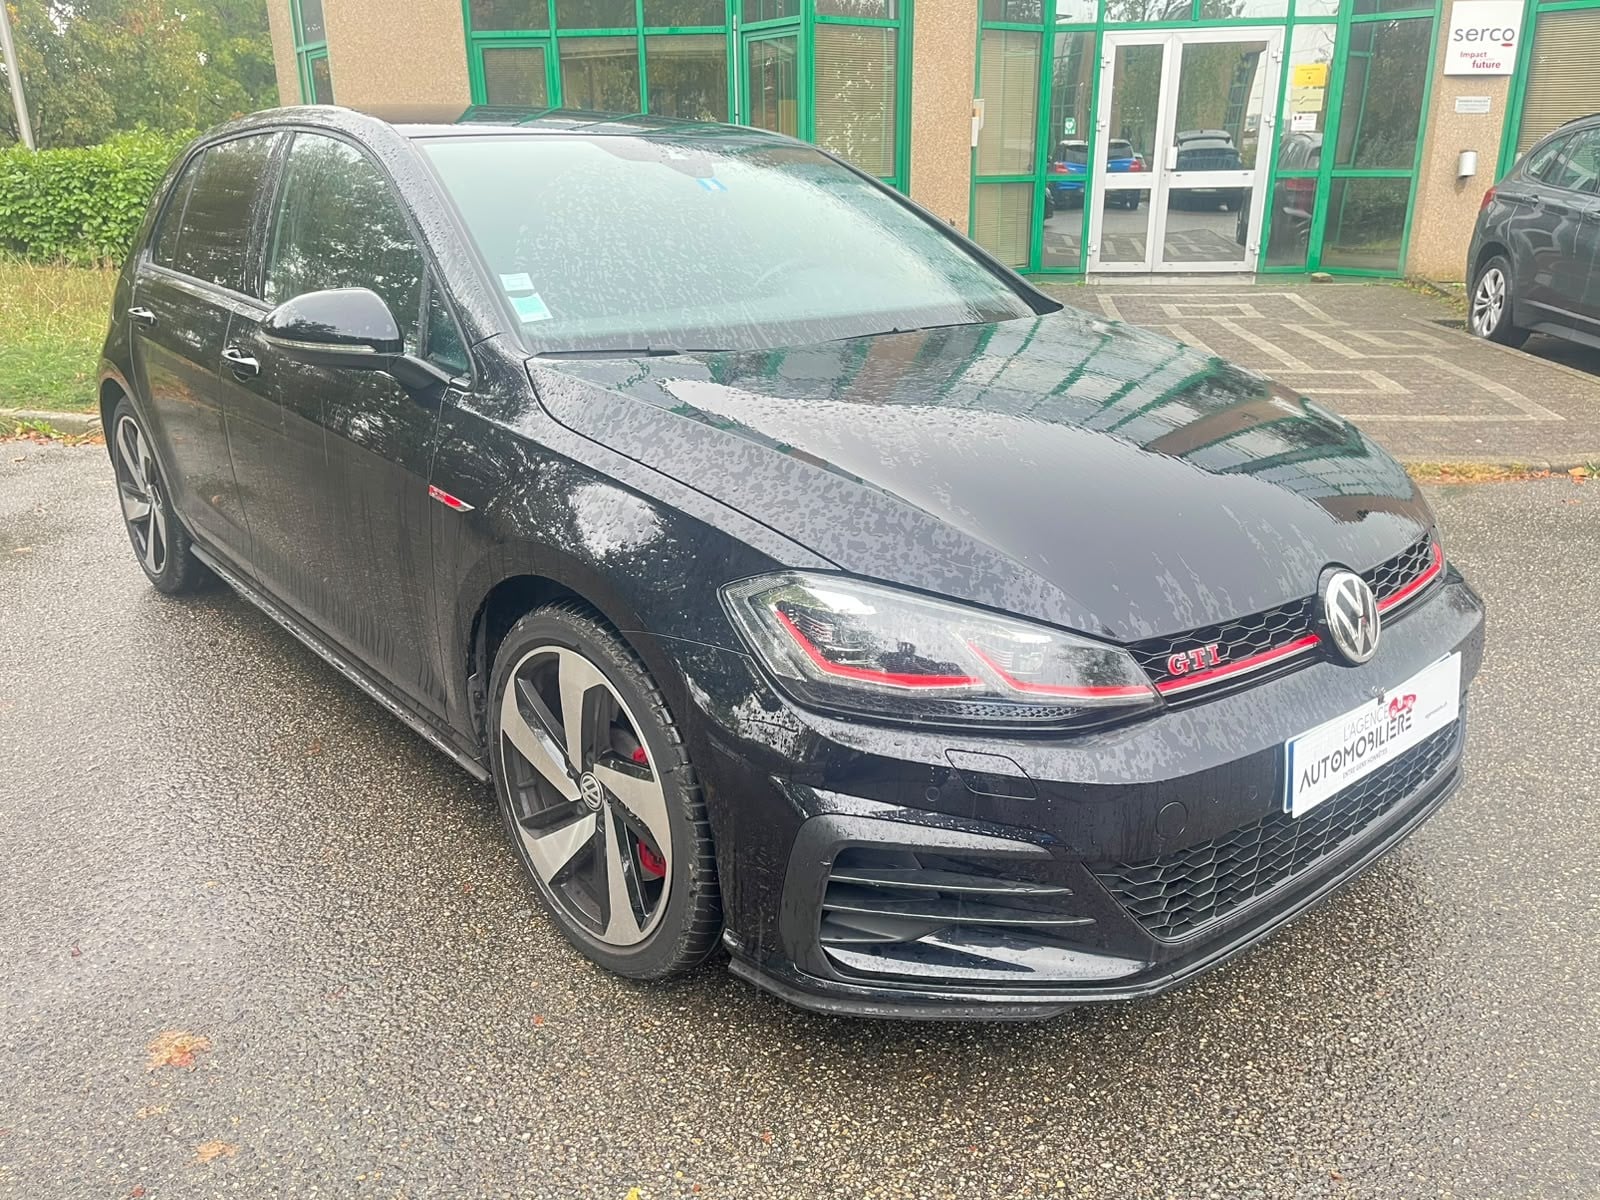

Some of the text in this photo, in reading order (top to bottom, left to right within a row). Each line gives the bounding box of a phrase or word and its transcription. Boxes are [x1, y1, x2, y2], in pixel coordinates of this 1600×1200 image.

[1453, 28, 1515, 42] serco
[1472, 60, 1501, 69] future
[1168, 644, 1221, 676] GTI
[1343, 708, 1390, 741] L'AGENCE
